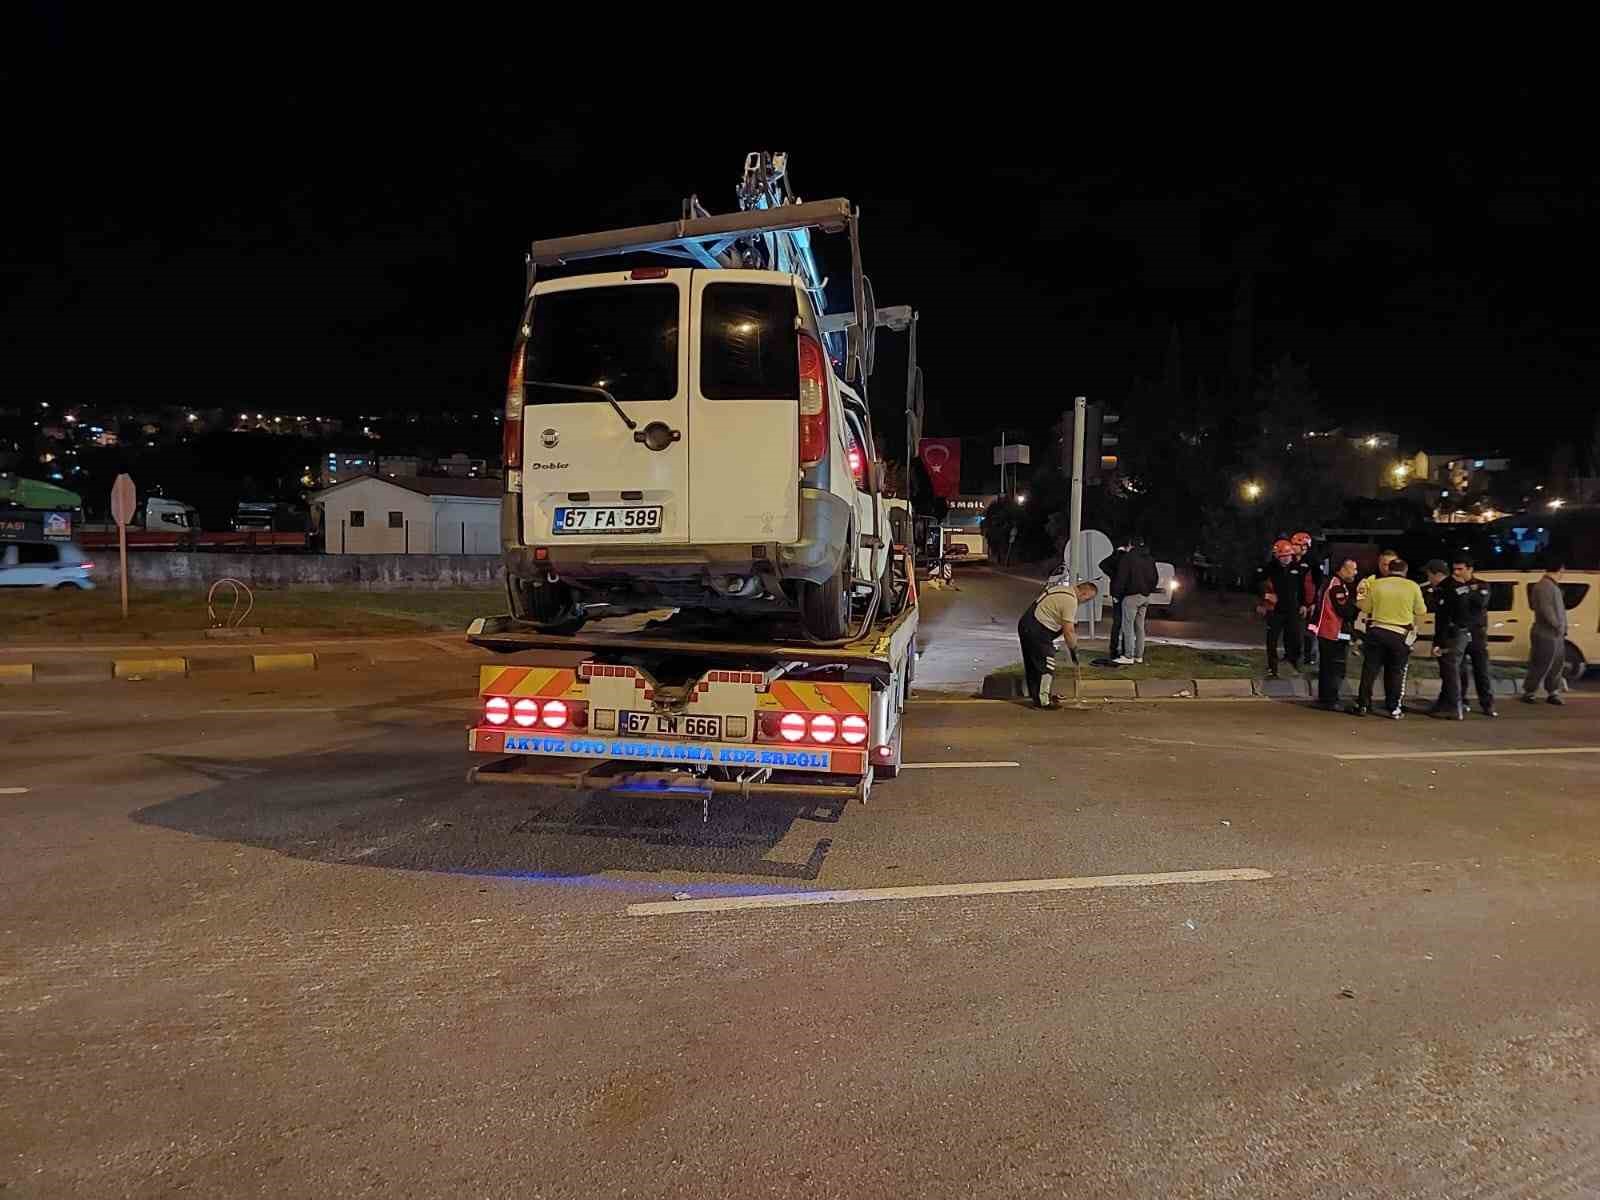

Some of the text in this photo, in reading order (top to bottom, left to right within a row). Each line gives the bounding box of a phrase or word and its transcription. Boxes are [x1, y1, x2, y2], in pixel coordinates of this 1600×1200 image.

[565, 510, 658, 527] 67 FA 589
[629, 714, 649, 731] 67
[657, 716, 678, 733] LN
[685, 718, 717, 736] 666
[569, 740, 606, 754] OTO
[610, 741, 713, 761] KURTARMA
